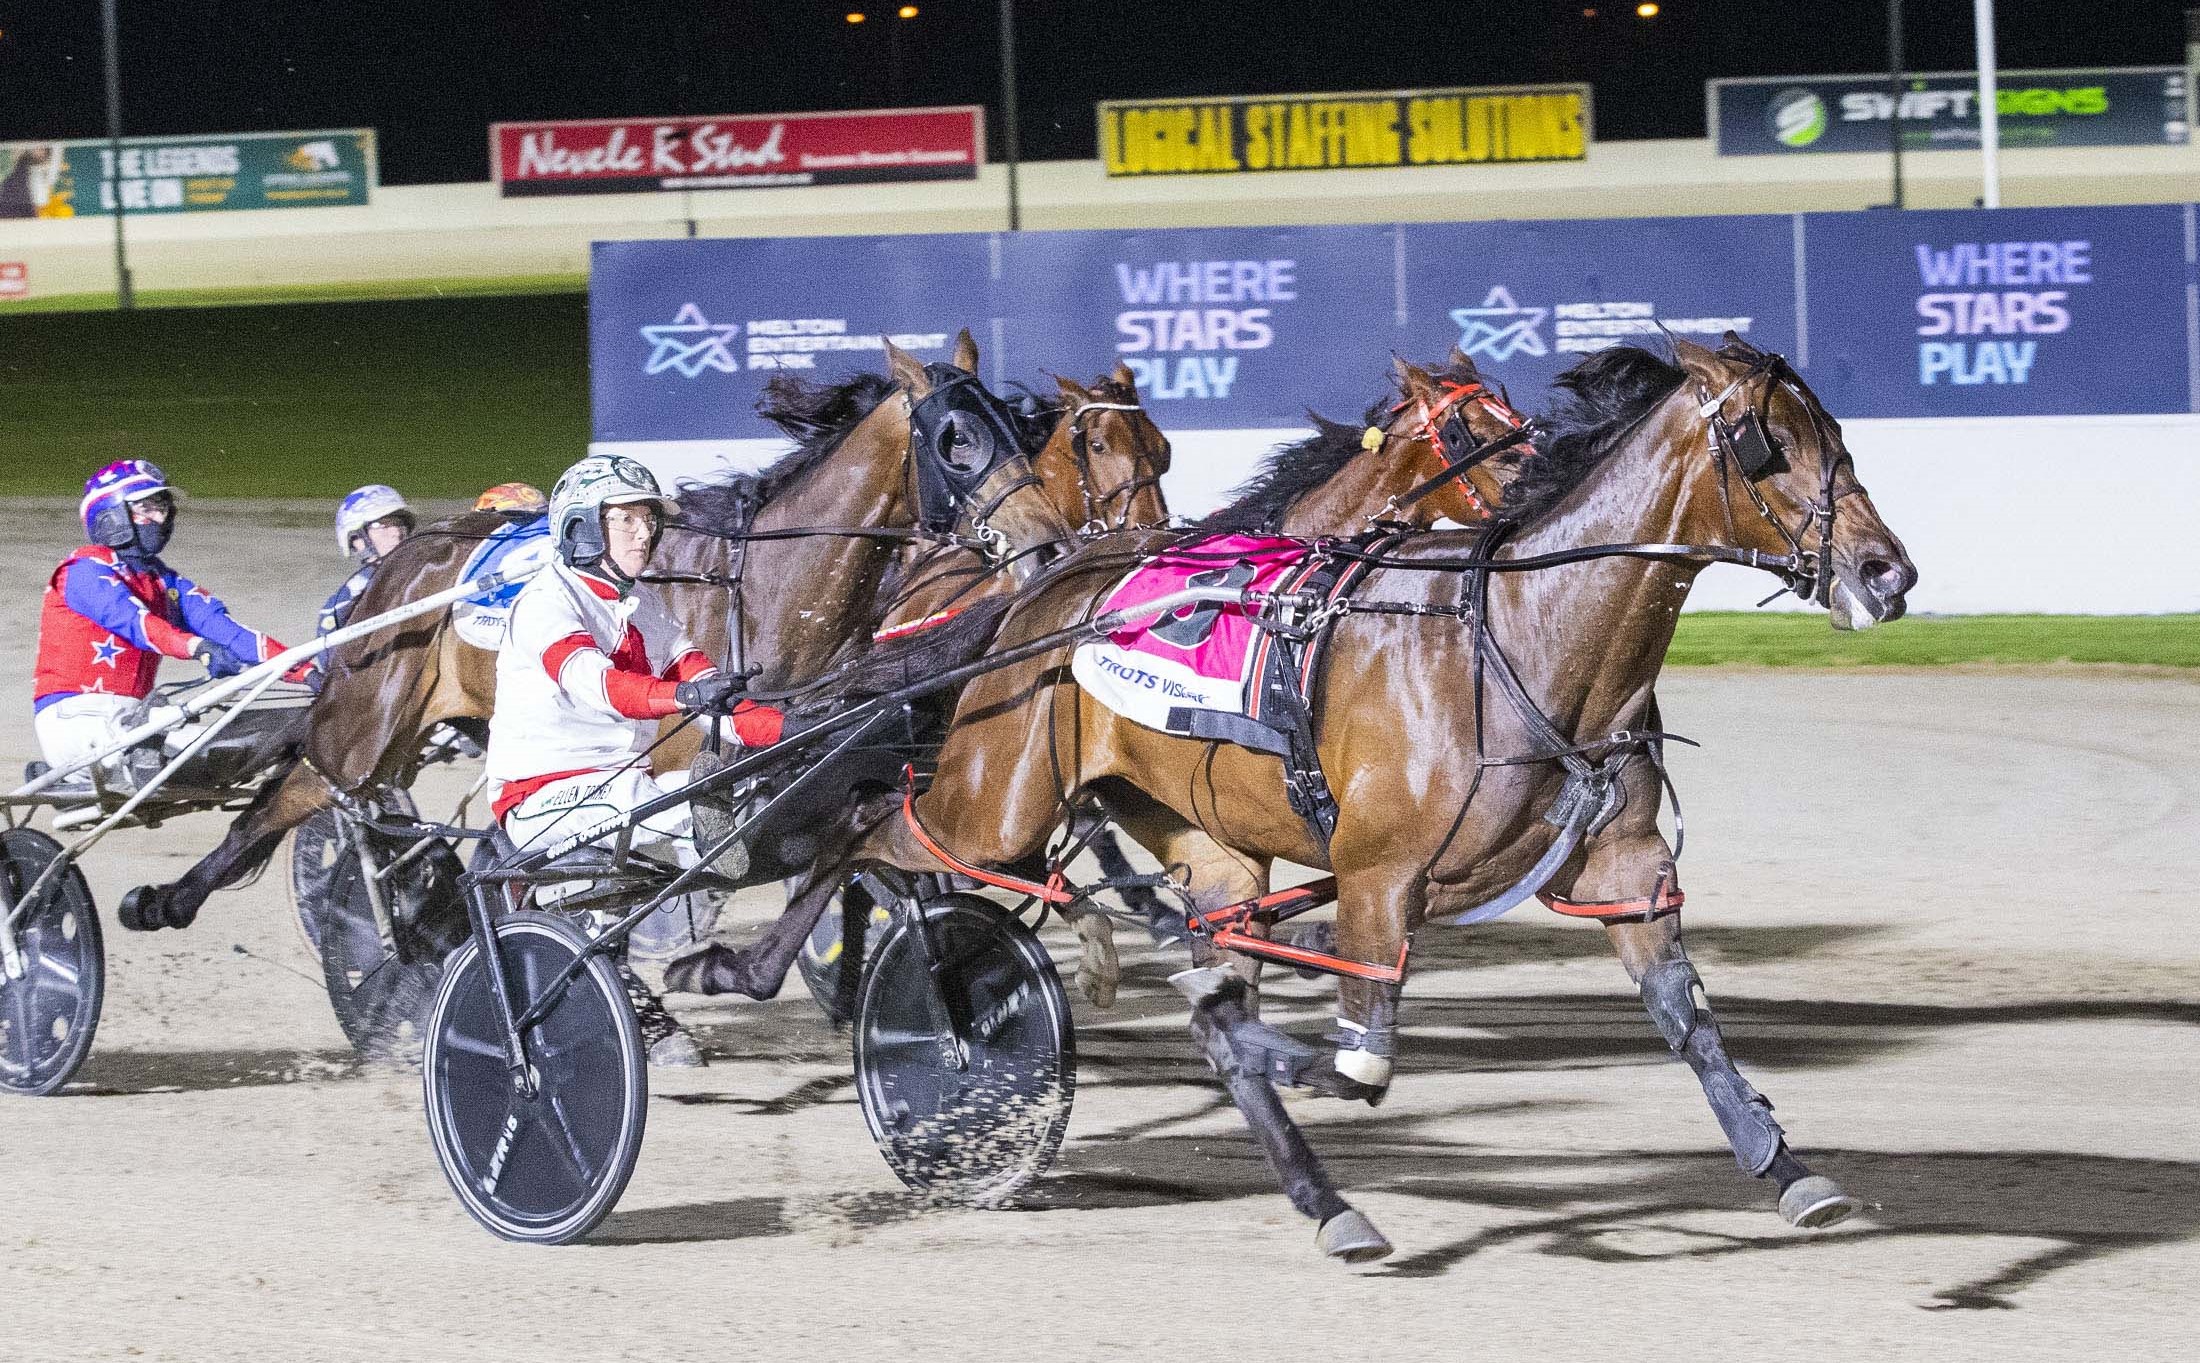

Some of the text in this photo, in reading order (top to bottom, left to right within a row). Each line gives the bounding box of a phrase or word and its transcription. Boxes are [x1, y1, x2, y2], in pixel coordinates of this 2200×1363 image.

[1117, 260, 1298, 303] WHERE
[1915, 240, 2094, 287] WHERE
[1116, 308, 1274, 352] STARS
[1916, 291, 2072, 335] STARS
[1120, 356, 1239, 400] PLAY
[1919, 340, 2038, 385] PLAY
[1098, 655, 1160, 690] TROTS
